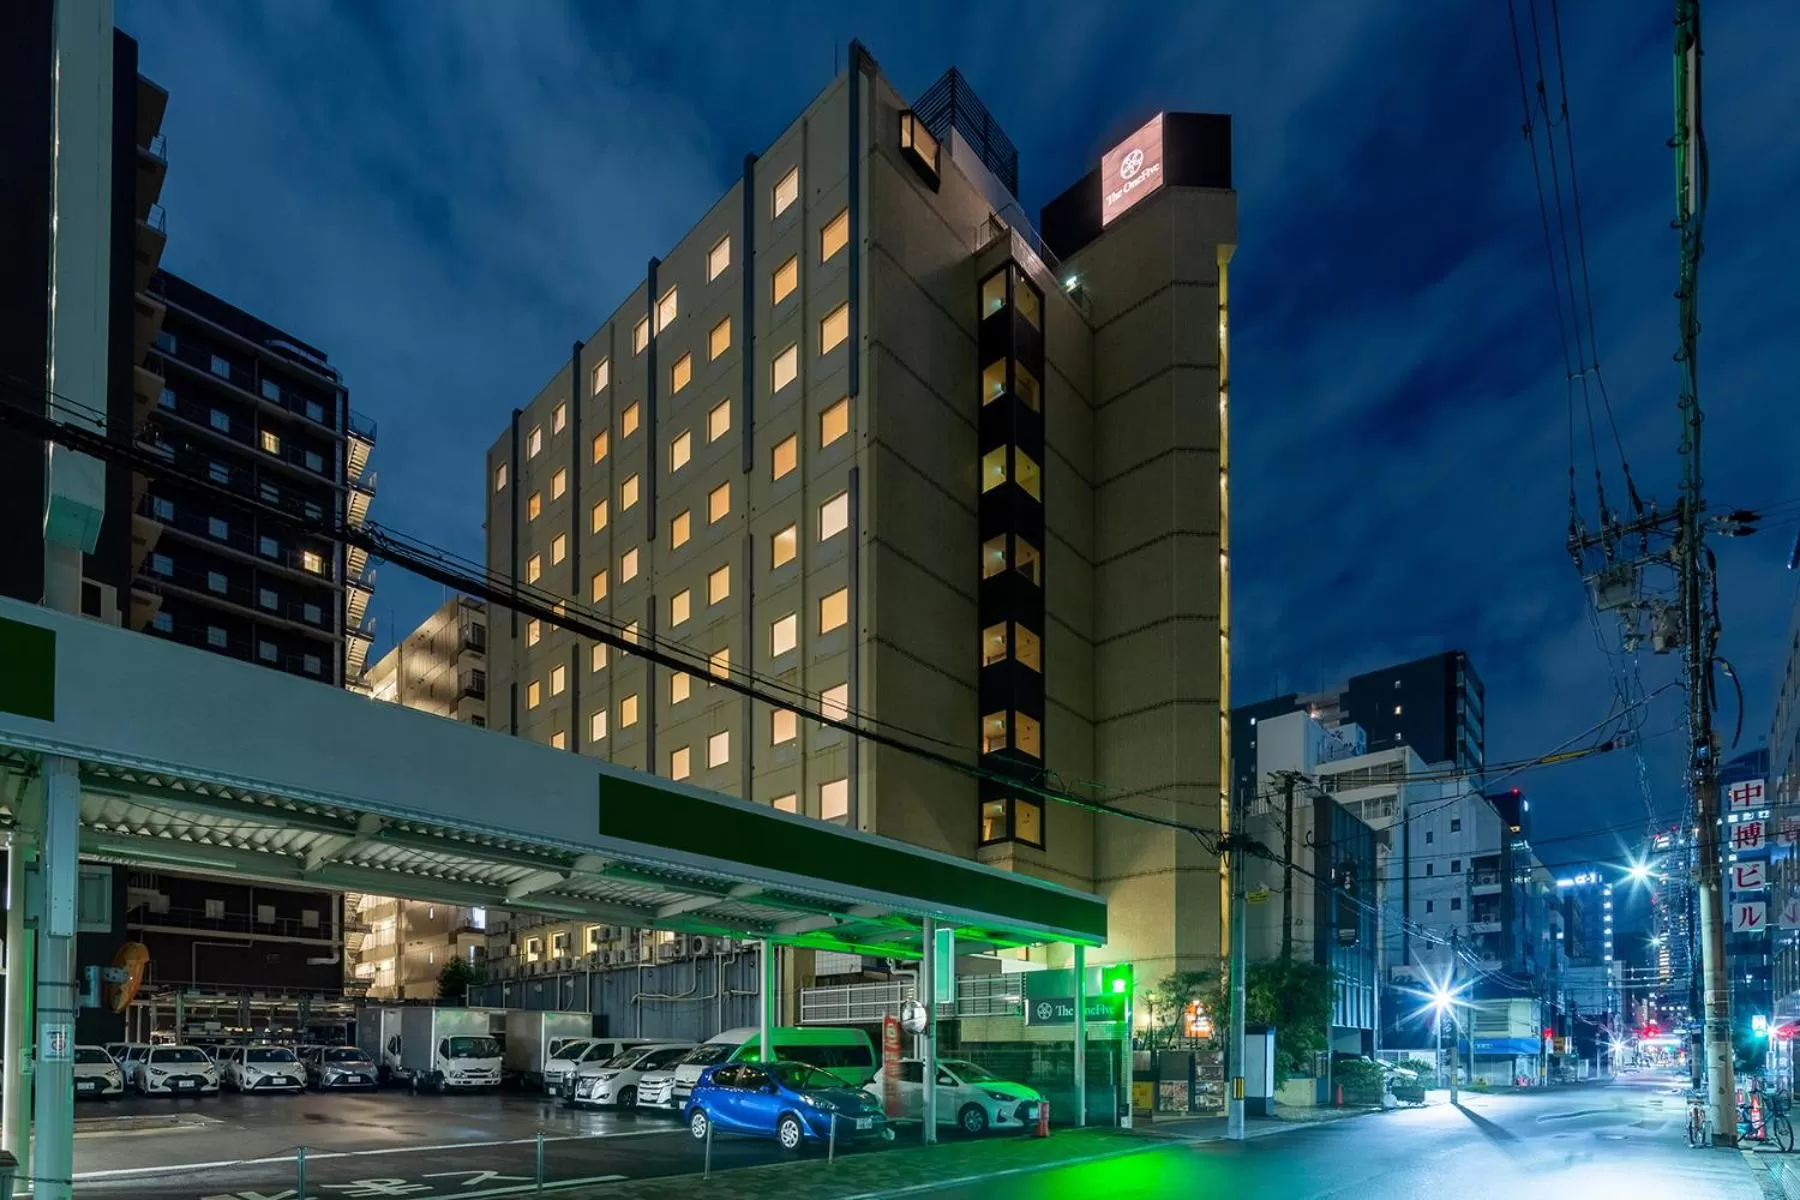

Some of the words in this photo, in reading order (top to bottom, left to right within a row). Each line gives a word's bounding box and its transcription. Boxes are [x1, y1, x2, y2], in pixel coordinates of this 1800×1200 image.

[1105, 190, 1124, 206] The
[1733, 782, 1763, 928] 中博ビル
[1055, 1004, 1074, 1017] The
[1083, 1003, 1115, 1017] neFive
